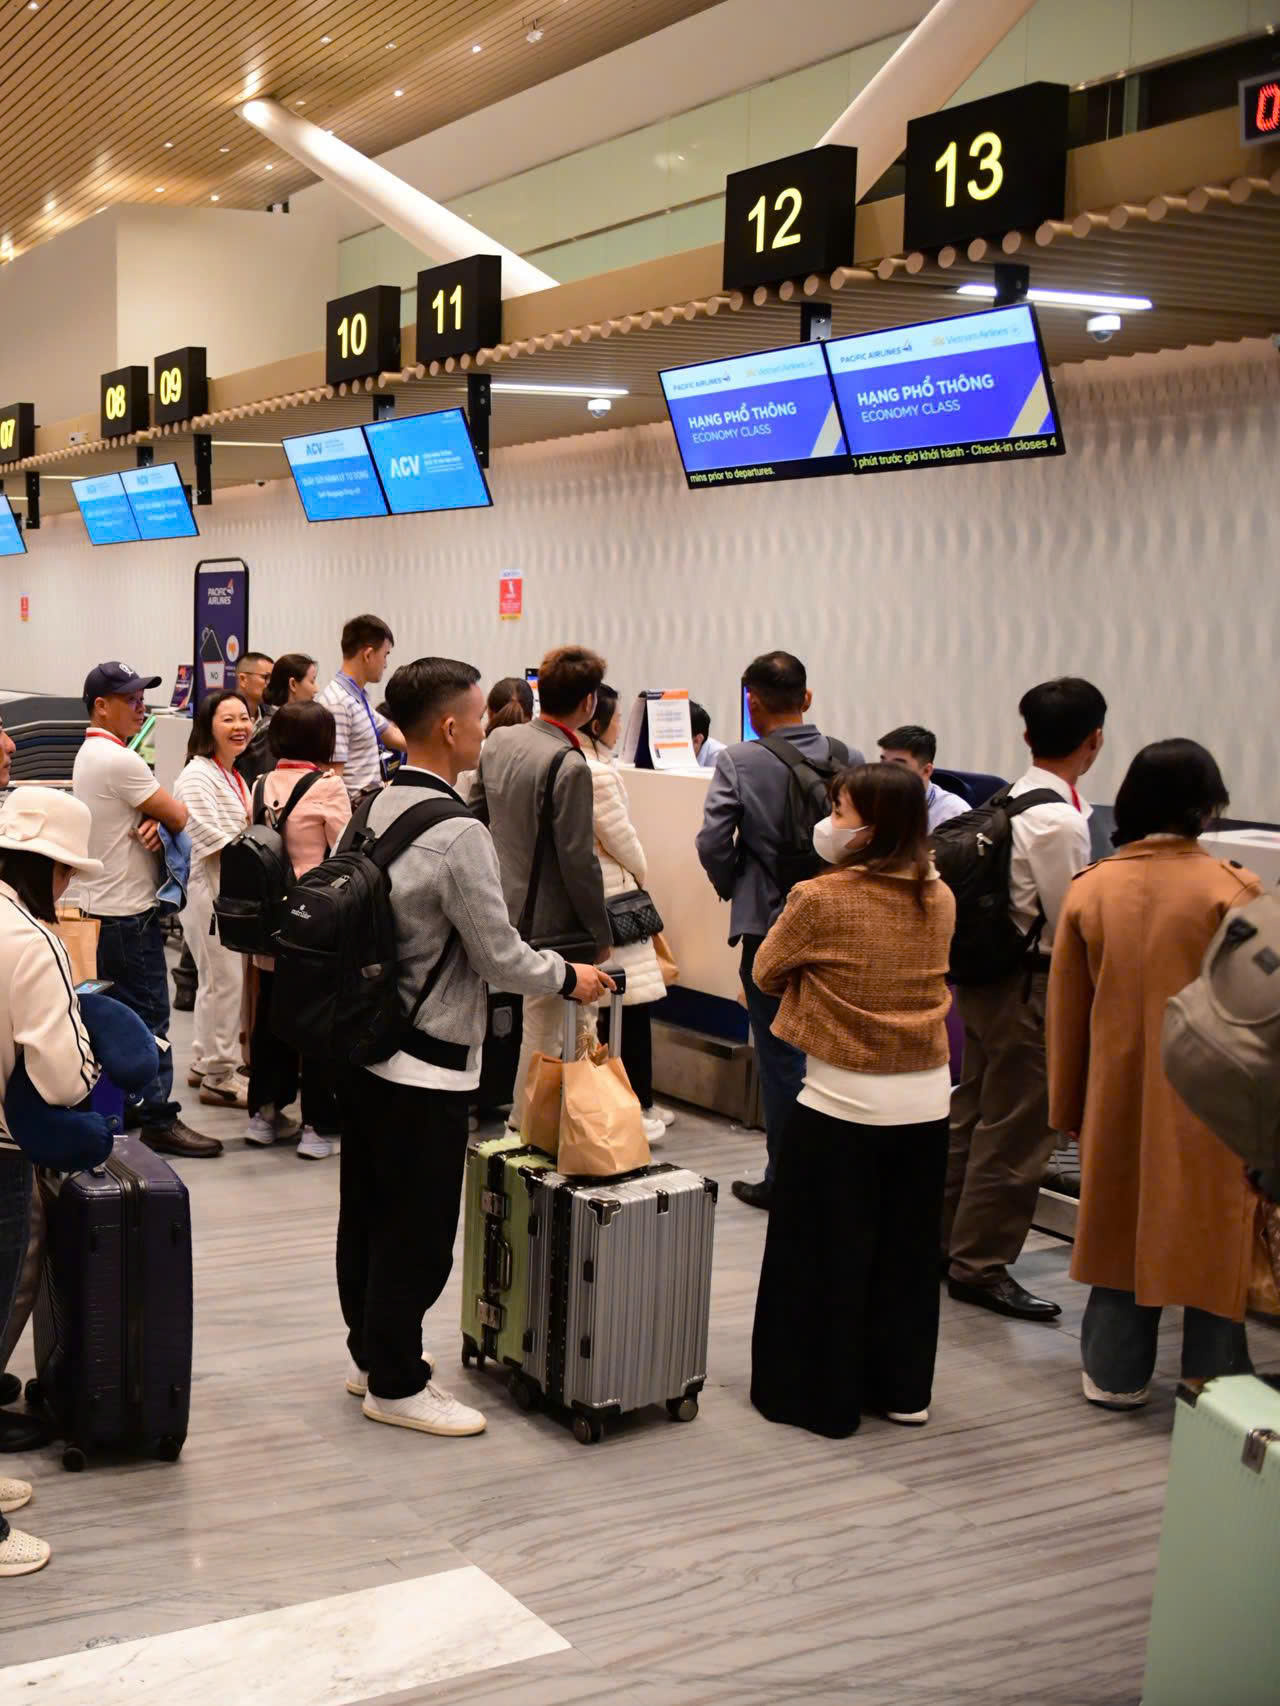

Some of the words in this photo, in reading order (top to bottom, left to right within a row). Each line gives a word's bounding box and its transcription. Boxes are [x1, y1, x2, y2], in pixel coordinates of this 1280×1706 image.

[935, 131, 1004, 208] 13
[748, 187, 803, 253] 12
[432, 284, 462, 334] 11
[337, 312, 367, 359] 10
[840, 352, 867, 364] PACIFIC
[867, 345, 902, 359] AIRLINES
[160, 367, 182, 405] 09
[857, 386, 900, 409] HẠNG
[902, 374, 934, 400] PHỔ
[937, 373, 995, 395] THÔNG
[106, 384, 126, 420] 08
[688, 414, 723, 431] HẠNG
[724, 402, 750, 423] PHỔ
[751, 401, 798, 418] THÔNG
[862, 407, 918, 423] ECONOMY
[922, 399, 961, 416] CLASS
[0, 418, 16, 450] 07
[692, 428, 739, 444] ECONOMY
[740, 423, 772, 437] CLASS
[306, 442, 323, 456] ACV
[858, 453, 879, 469] phút
[904, 450, 919, 464] giờ
[941, 446, 965, 458] hành
[970, 443, 1013, 456] Check-in
[1014, 440, 1048, 452] closes
[390, 455, 420, 478] ACV
[690, 473, 708, 483] mins
[708, 471, 725, 483] prior
[725, 470, 734, 479] to
[207, 587, 227, 596] PACIFIC
[207, 596, 232, 606] AIRLINES
